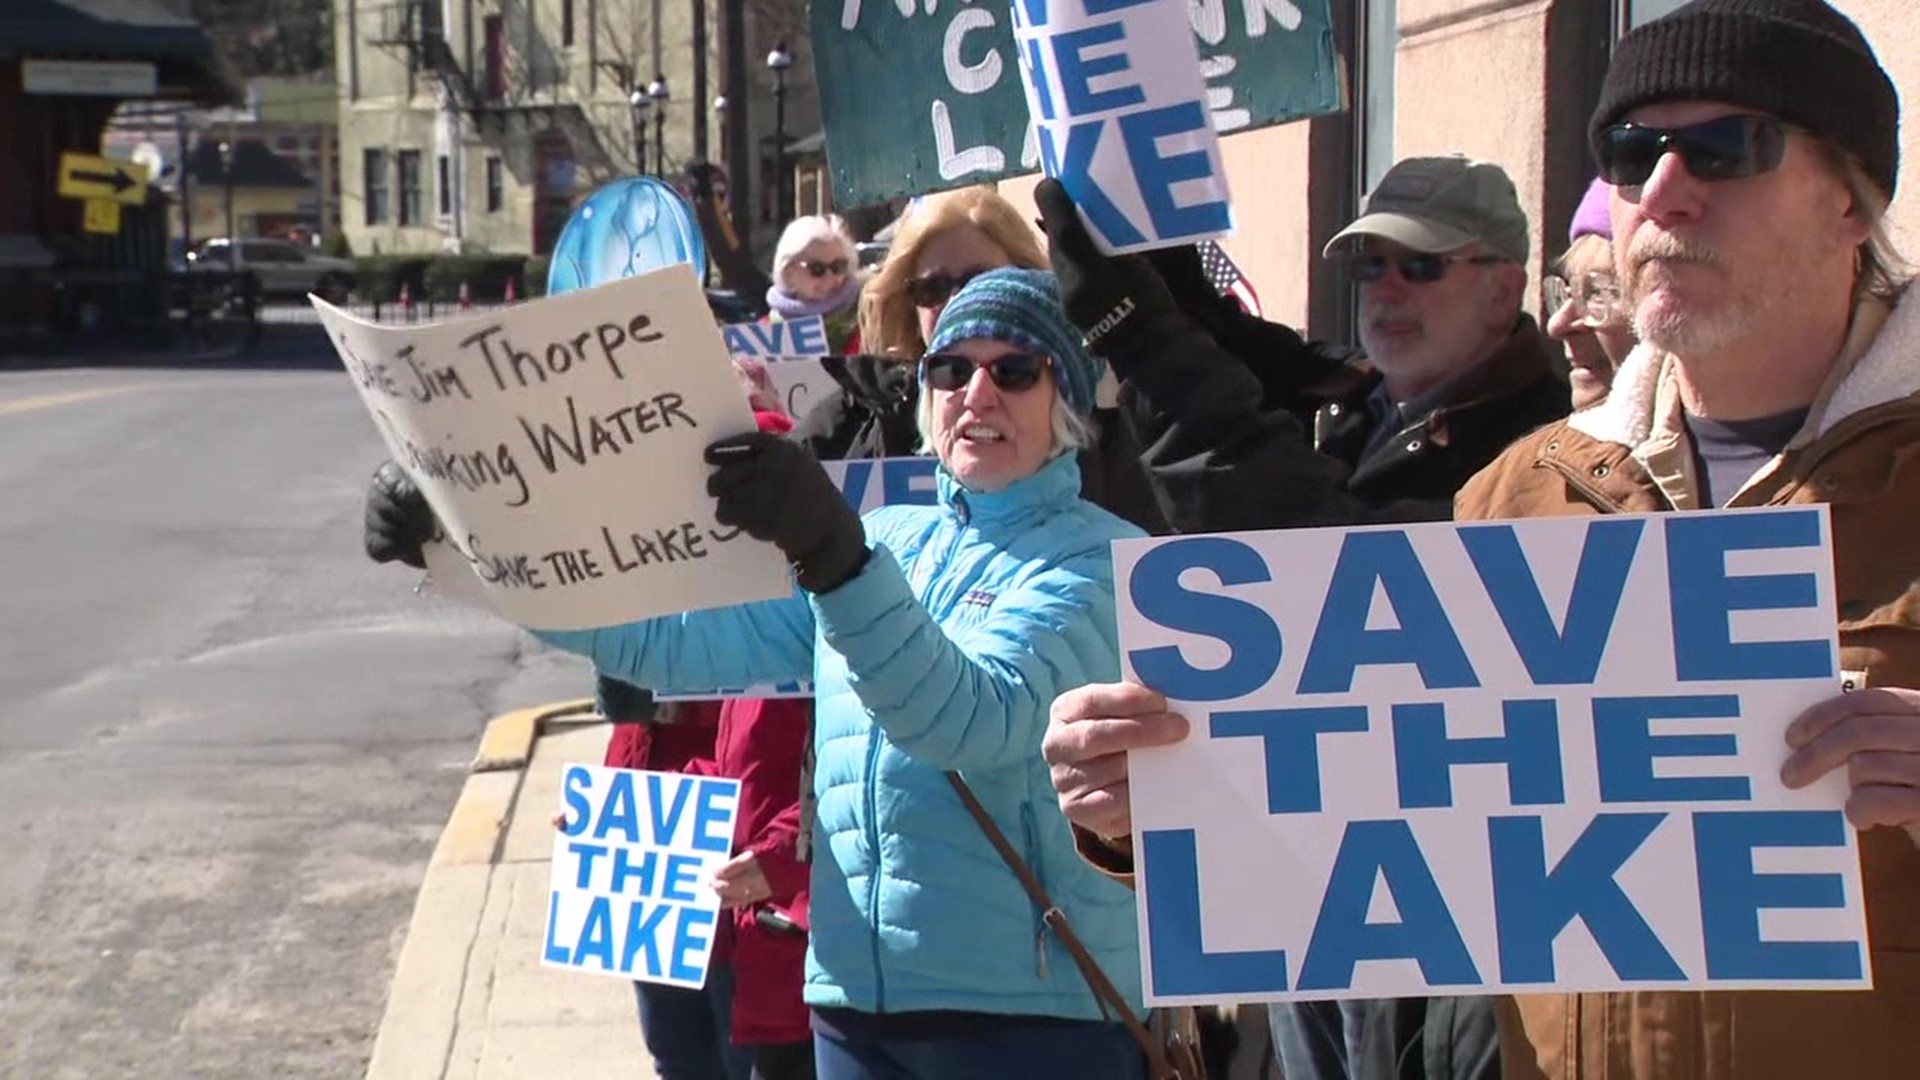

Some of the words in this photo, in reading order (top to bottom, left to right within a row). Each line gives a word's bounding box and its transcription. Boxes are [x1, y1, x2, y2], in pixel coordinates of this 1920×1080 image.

[459, 312, 665, 391] Thorpe
[722, 317, 828, 356] AVE
[517, 393, 698, 475] WATER
[543, 550, 604, 586] THE
[1129, 511, 1832, 702] SAVE
[1209, 695, 1752, 814] THE
[563, 767, 738, 853] SAVE
[567, 843, 703, 902] THE
[1142, 811, 1862, 997] LAKE
[545, 891, 714, 983] LAKE
